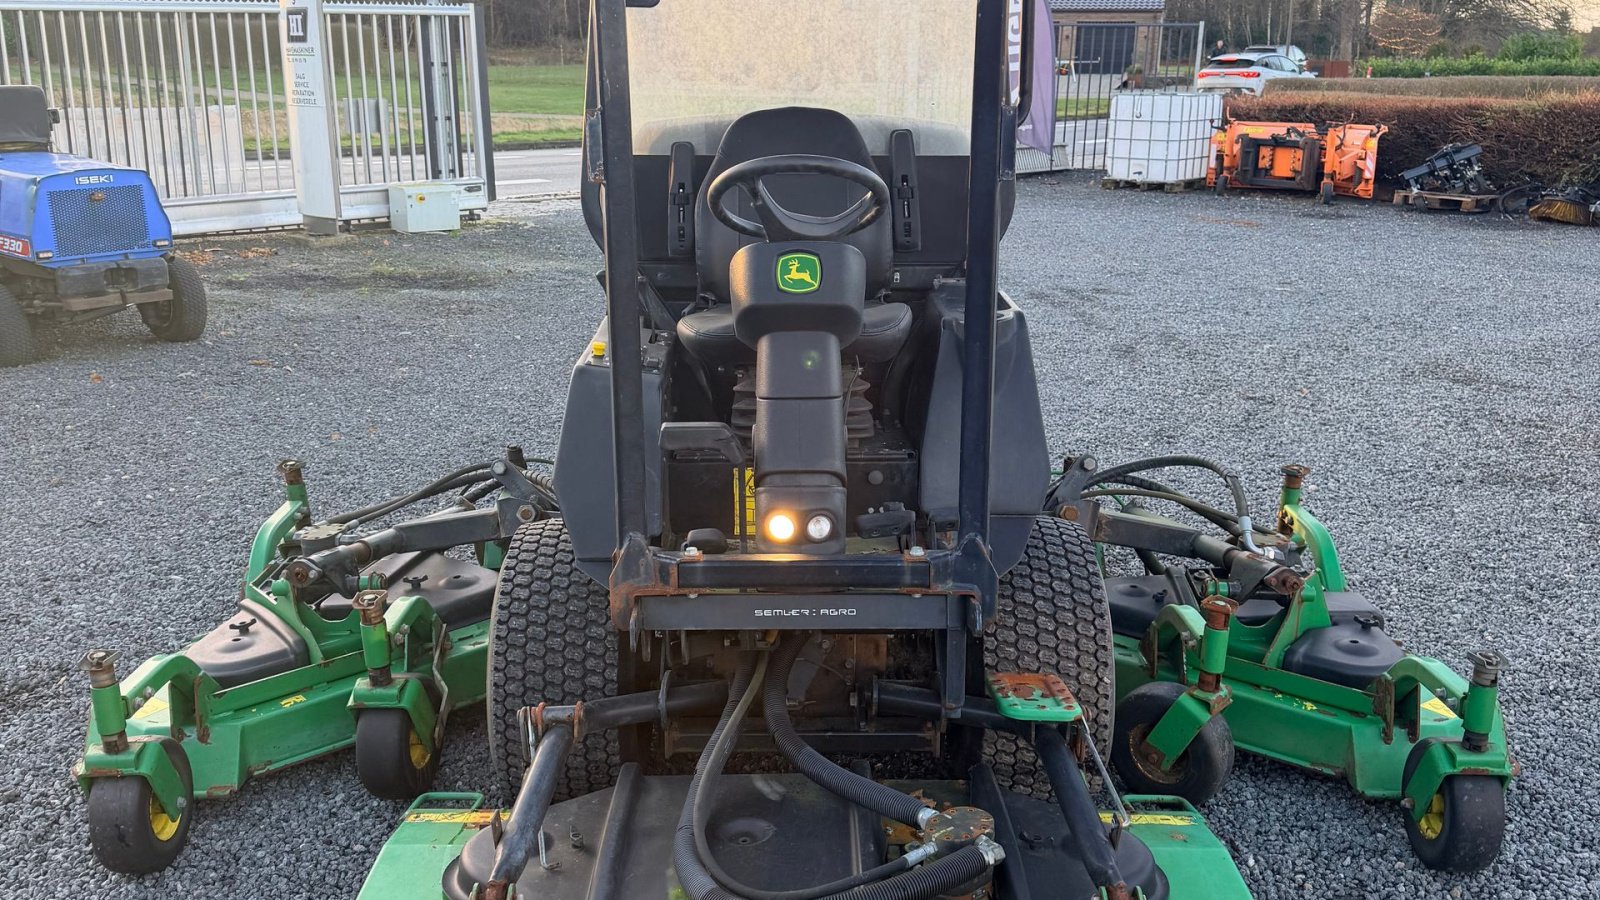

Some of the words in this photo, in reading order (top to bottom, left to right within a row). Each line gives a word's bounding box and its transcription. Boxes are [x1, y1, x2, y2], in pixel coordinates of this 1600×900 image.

[75, 174, 114, 185] ISEKI
[754, 609, 810, 617] SEMLER
[820, 608, 857, 616] AGRO
